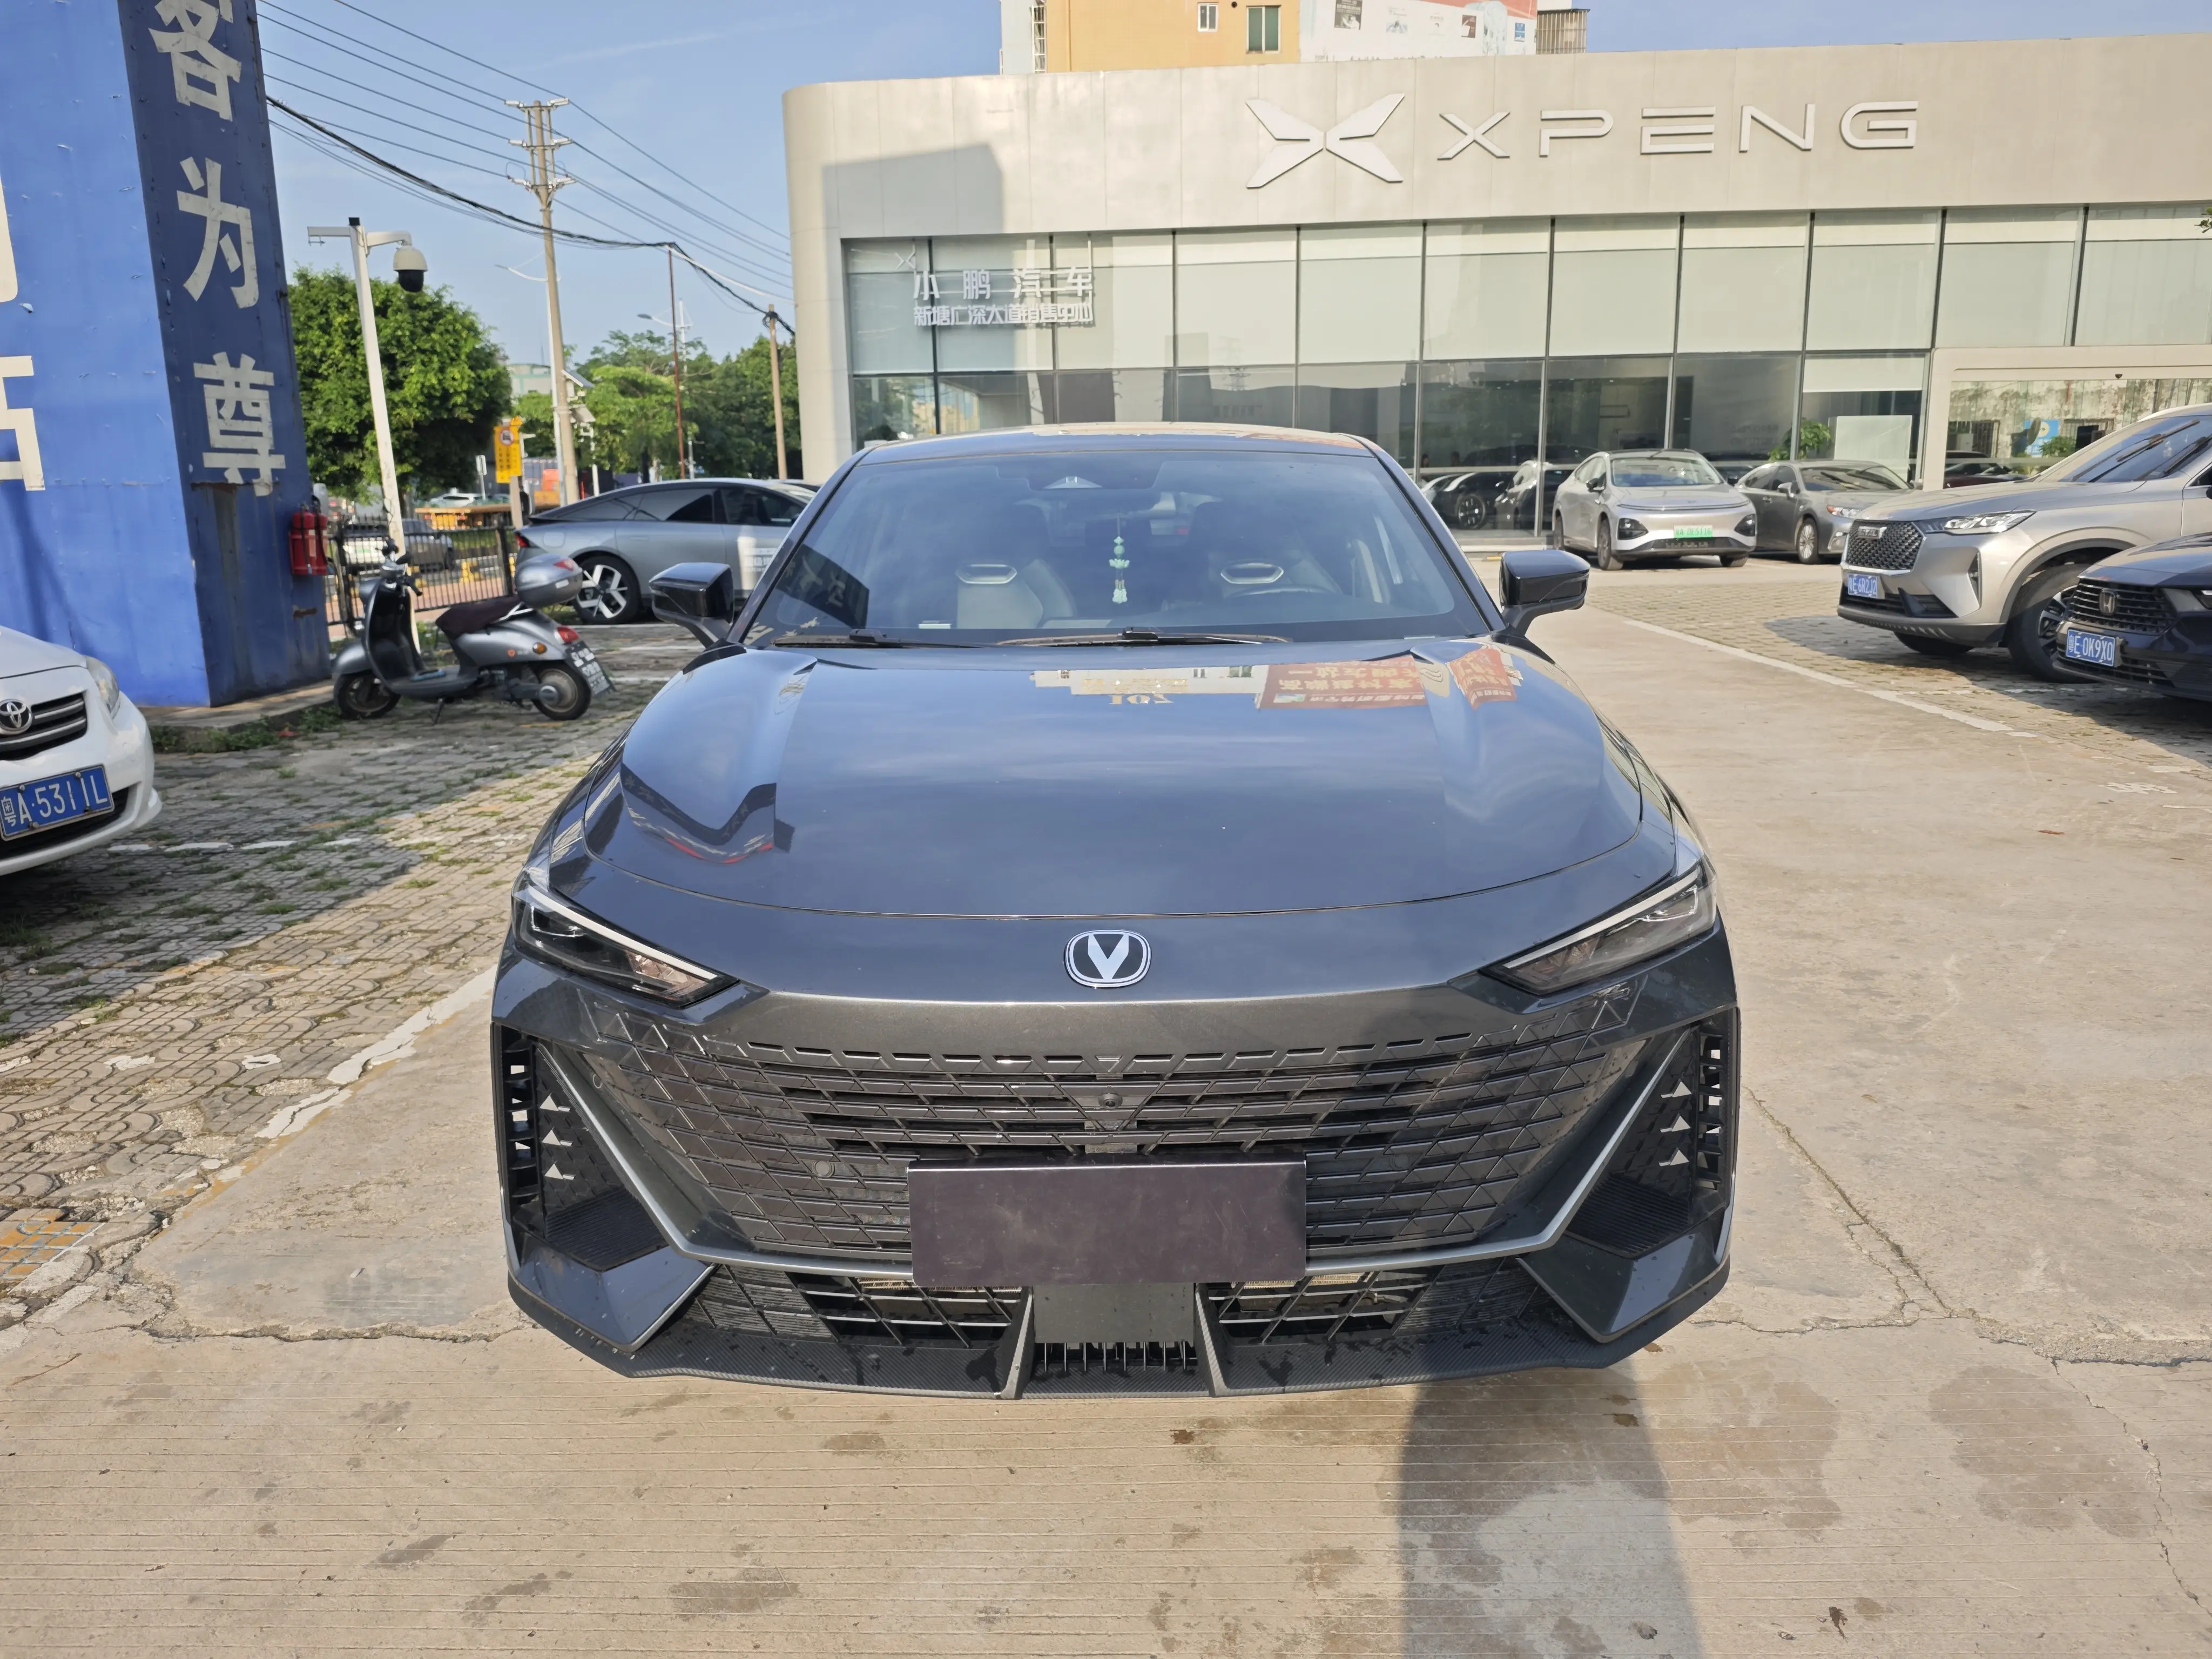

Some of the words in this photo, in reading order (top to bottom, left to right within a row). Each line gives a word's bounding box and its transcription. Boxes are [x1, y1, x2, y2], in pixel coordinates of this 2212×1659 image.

[1437, 100, 1919, 160] XPENG
[149, 0, 285, 496] 客为尊
[913, 266, 1092, 301] 小鹏汽车
[913, 301, 1094, 326] 新塘广深大道销售中心
